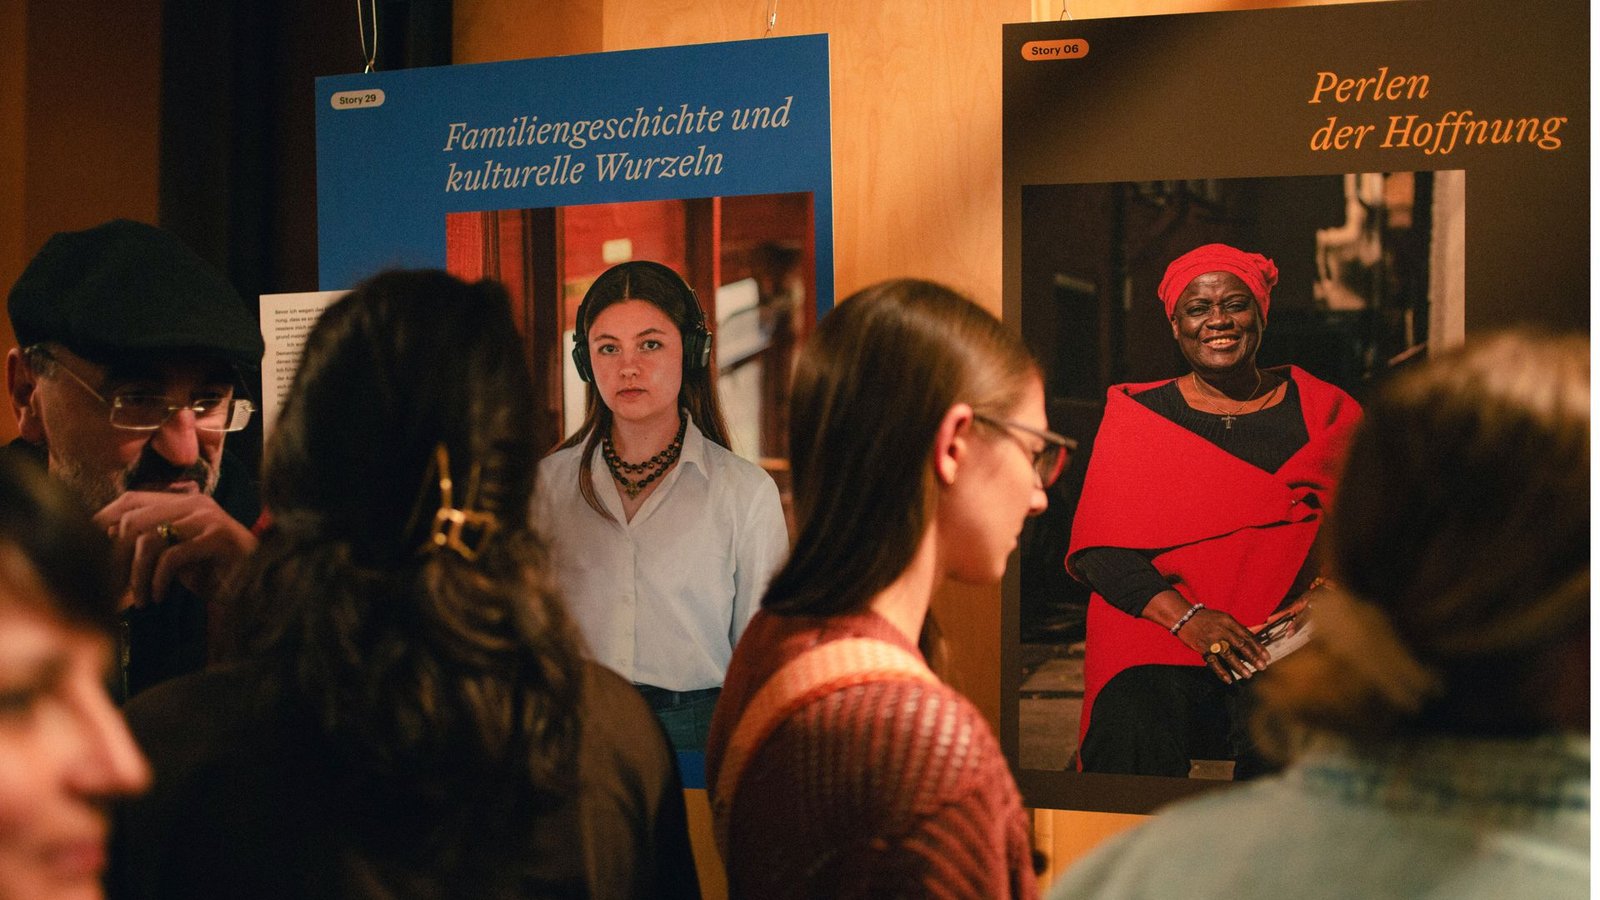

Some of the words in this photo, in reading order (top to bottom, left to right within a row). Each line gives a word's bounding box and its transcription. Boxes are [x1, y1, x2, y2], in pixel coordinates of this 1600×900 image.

[1031, 46, 1060, 56] Story
[1063, 44, 1079, 53] 06
[339, 96, 363, 105] Story
[365, 93, 377, 103] 29
[1308, 66, 1430, 104] Perlen
[443, 103, 724, 151] Familiengeschichte
[731, 95, 794, 130] und
[1310, 116, 1375, 151] der
[1380, 110, 1568, 155] Hoffnung
[445, 154, 586, 193] kulturelle
[595, 145, 724, 183] Wurzeln
